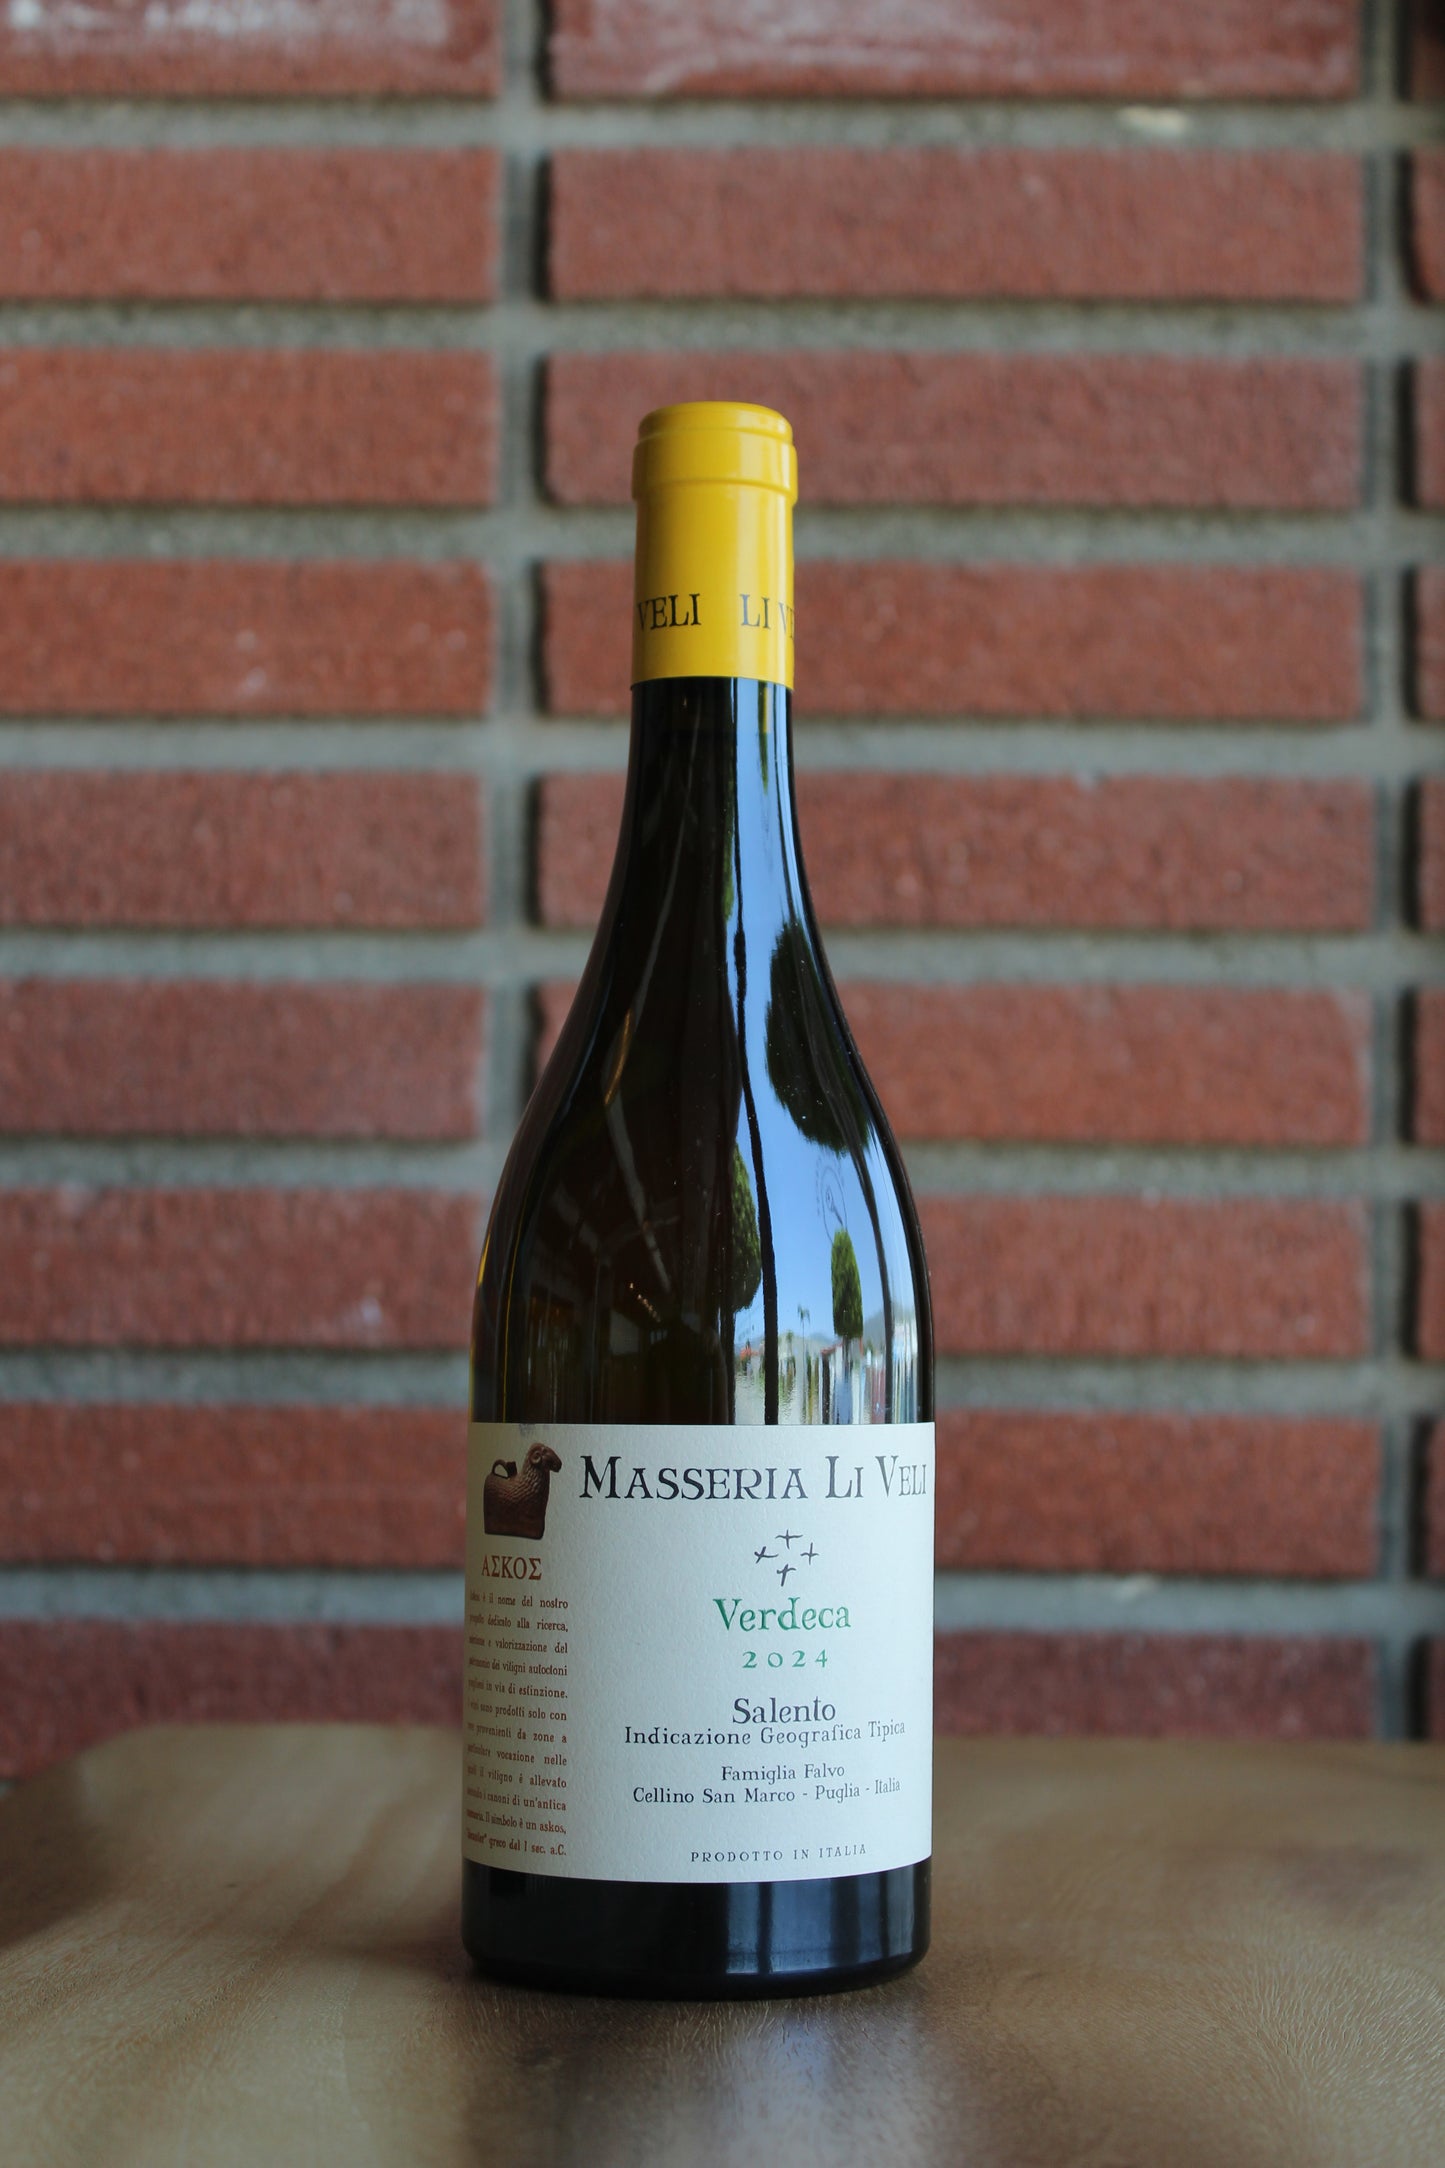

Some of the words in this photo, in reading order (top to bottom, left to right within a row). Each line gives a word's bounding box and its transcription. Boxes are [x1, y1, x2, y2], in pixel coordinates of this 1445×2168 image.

[638, 593, 702, 631] VELI
[740, 594, 771, 629] LI
[580, 1455, 808, 1500] MASSERIA
[498, 1596, 516, 1606] nome
[522, 1596, 532, 1606] del
[540, 1599, 568, 1609] nostro
[713, 1596, 851, 1632] Verdeca
[517, 1618, 530, 1628] alla
[537, 1619, 568, 1632] ricerca,
[496, 1638, 548, 1652] valorizzazione
[554, 1642, 568, 1654] del
[742, 1649, 829, 1669] 2024
[503, 1661, 526, 1675] vitigni
[529, 1665, 567, 1676] autoctoni
[495, 1682, 505, 1693] via
[508, 1684, 516, 1694] di
[519, 1686, 568, 1698] estinzione.
[495, 1706, 525, 1717] prodotti
[528, 1708, 546, 1719] solo
[550, 1712, 567, 1721] con
[732, 1696, 836, 1724] Salento
[517, 1729, 526, 1740] da
[533, 1733, 554, 1742] zone
[562, 1735, 567, 1743] a
[625, 1726, 751, 1745] Indicazione
[760, 1723, 862, 1748] Geografica
[868, 1719, 906, 1741] Tipica
[497, 1751, 535, 1763] vocazione
[544, 1754, 567, 1766] nelle
[530, 1776, 567, 1788] allevato
[721, 1765, 797, 1785] Famiglia
[804, 1763, 845, 1778] Falvo
[633, 1787, 694, 1804] Cellino
[702, 1788, 735, 1803] San
[744, 1787, 795, 1802] Marco
[815, 1783, 860, 1803] Puglia
[875, 1777, 901, 1795] Italia
[487, 1792, 510, 1804] canoni
[512, 1794, 520, 1805] di
[523, 1797, 566, 1810] un'antica
[526, 1821, 536, 1830] un
[540, 1820, 566, 1834] askos,
[489, 1837, 506, 1848] greco
[509, 1838, 520, 1851] dal
[531, 1843, 546, 1853] sec.
[550, 1844, 566, 1856] a.C.
[691, 1850, 784, 1863] PRODOTTO
[793, 1848, 810, 1860] IN
[818, 1844, 867, 1858] ITALIA
